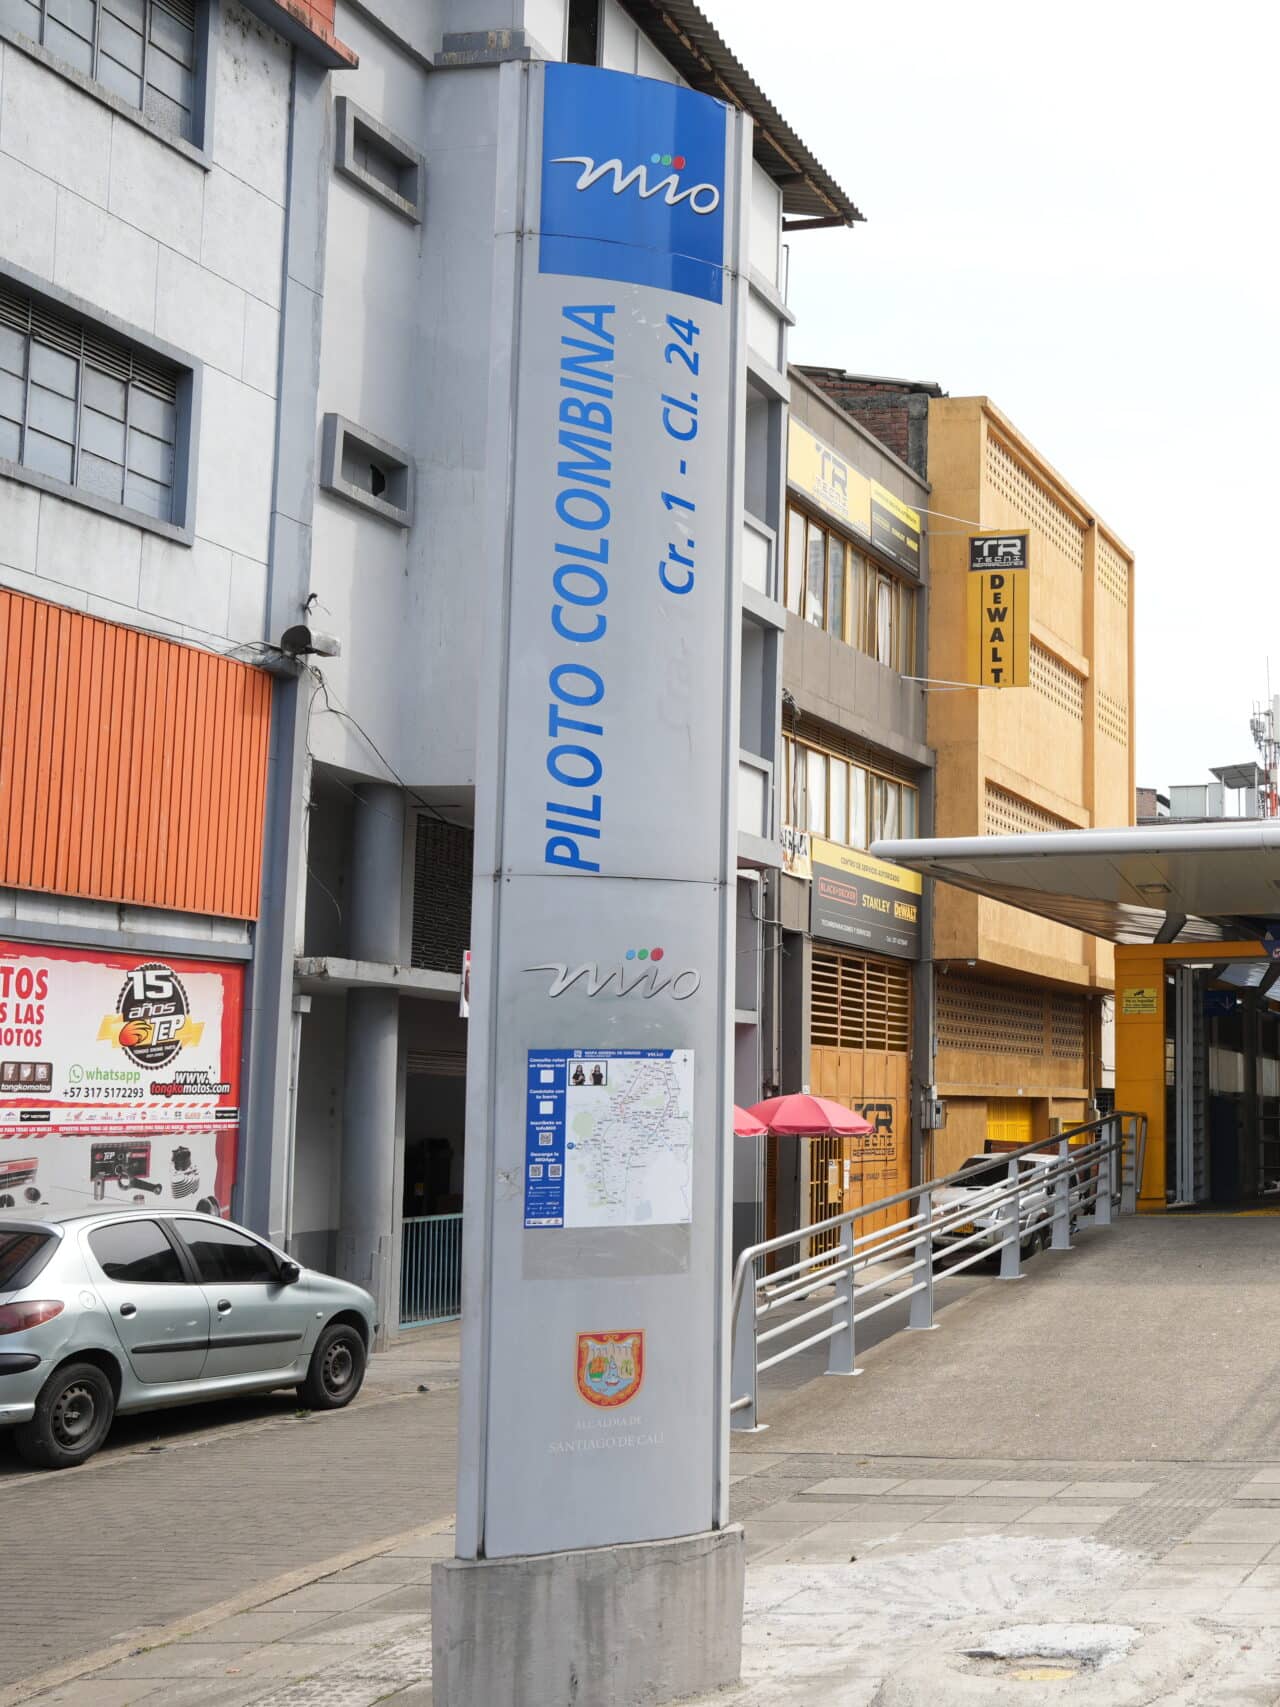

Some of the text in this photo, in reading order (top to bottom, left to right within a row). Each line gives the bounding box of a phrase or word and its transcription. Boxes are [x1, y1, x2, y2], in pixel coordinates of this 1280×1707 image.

[664, 314, 700, 376] 24
[661, 389, 698, 442] Cl.
[661, 492, 696, 512] 1
[974, 539, 1022, 556] TR
[658, 540, 695, 595] Cr.
[545, 304, 616, 873] PILOTO COLOMBINA
[987, 574, 1008, 684] DEWALT
[862, 894, 891, 914] STANLEY
[0, 966, 48, 1000] TOS
[128, 970, 173, 1000] 15
[15, 1003, 44, 1025] LAS
[129, 1002, 176, 1019] años
[151, 1014, 185, 1046] TEP
[86, 1068, 141, 1084] whatsapp
[175, 1071, 210, 1085] www.
[63, 1087, 144, 1098] +57 317 5172293
[150, 1082, 231, 1096] tongkomotos.com
